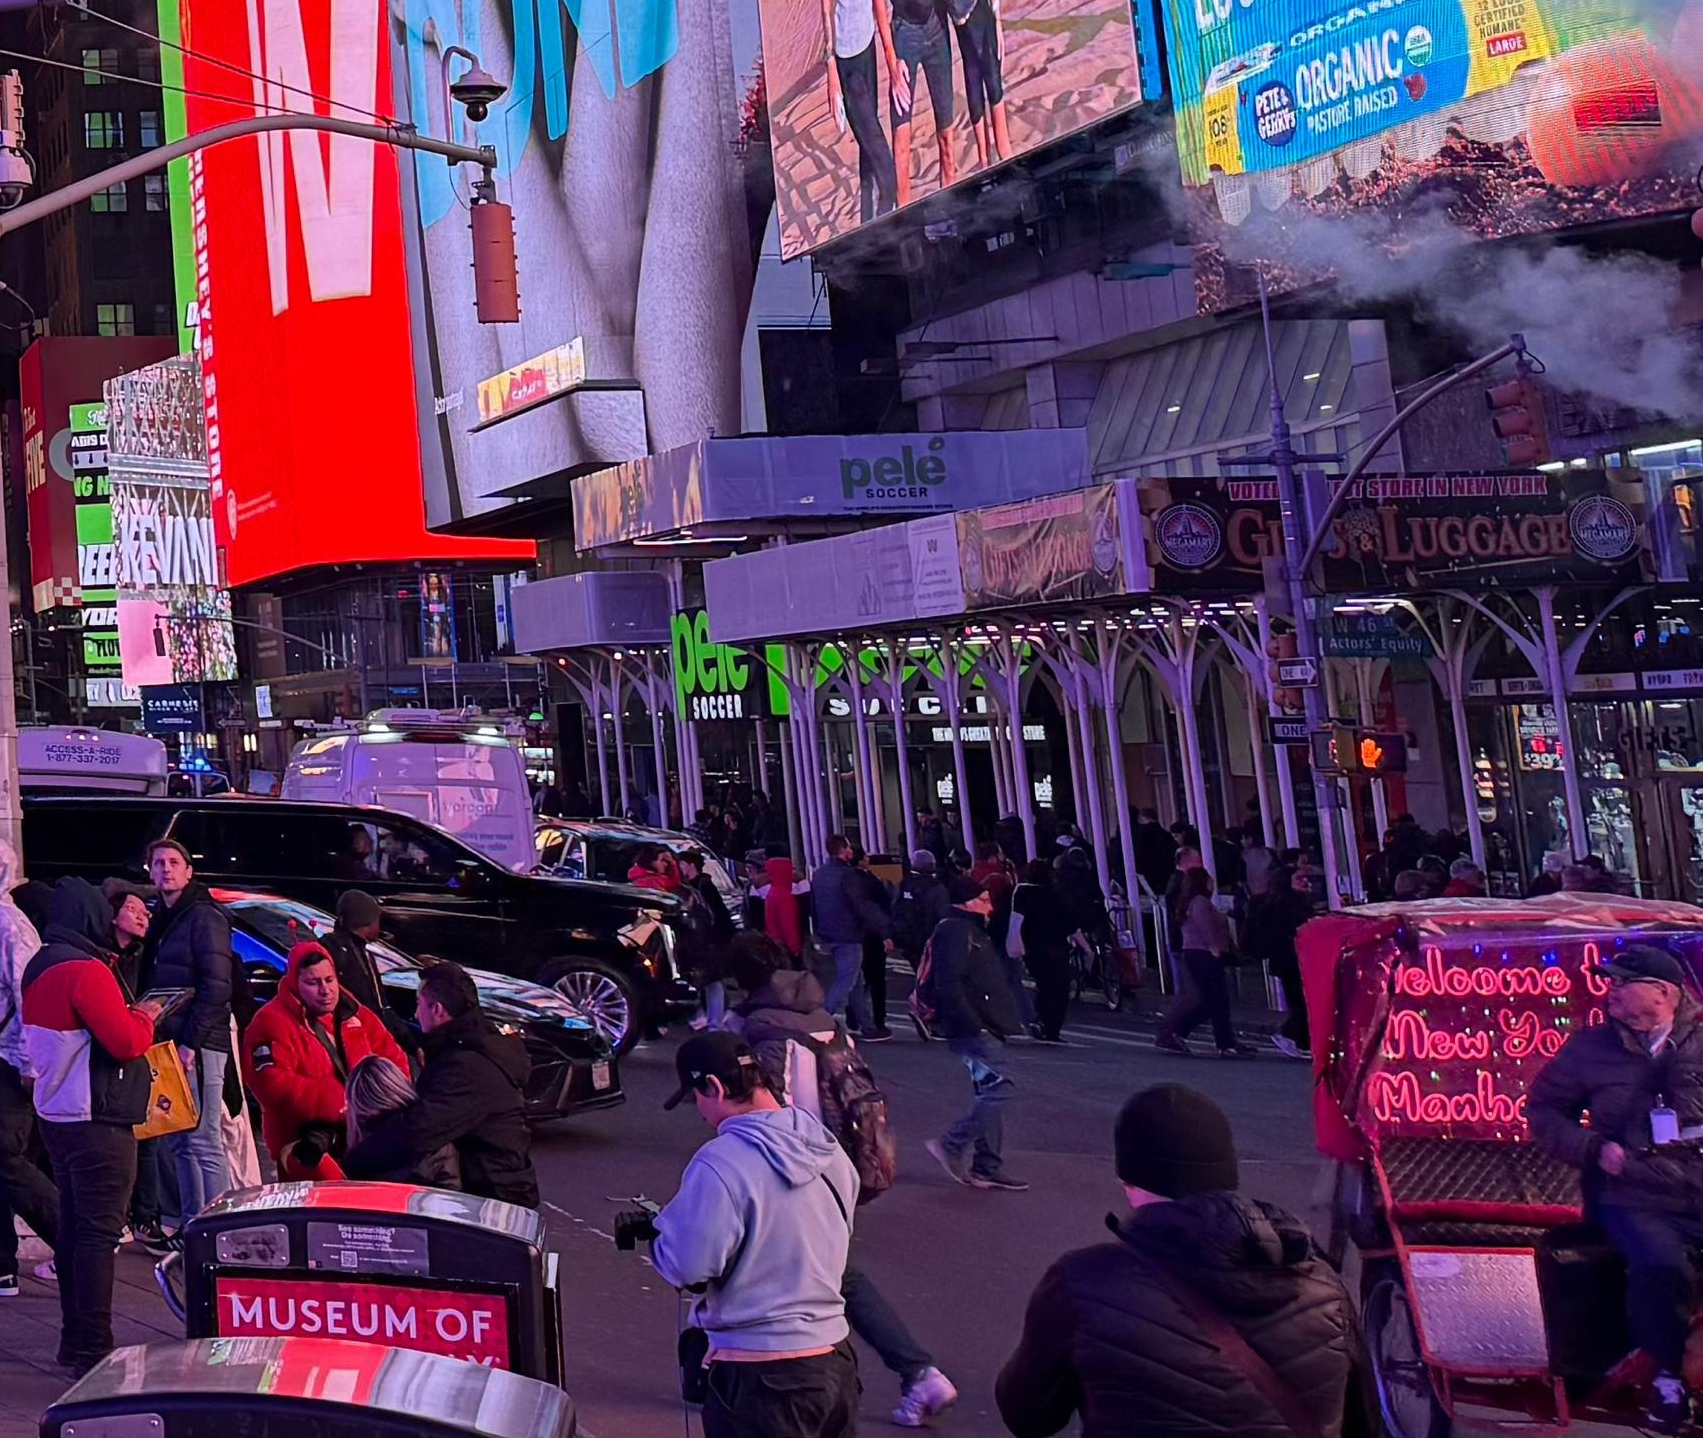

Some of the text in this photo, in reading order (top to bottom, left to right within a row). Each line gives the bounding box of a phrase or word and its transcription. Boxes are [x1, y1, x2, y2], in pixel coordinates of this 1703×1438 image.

[1473, 5, 1525, 27] CERTIFIED
[1489, 35, 1524, 53] LARGE
[1296, 29, 1405, 110] ORGANIC
[1255, 87, 1281, 117] PETE
[1354, 85, 1398, 119] RAISED
[840, 437, 947, 501] pelé
[865, 486, 929, 500] SOCCER
[1367, 475, 1548, 499] STORE IN NEW YORK
[1360, 506, 1572, 562] & LUGGAGE
[1333, 617, 1377, 635] W 46
[1381, 635, 1423, 655] Equity
[693, 694, 744, 721] SOCCER
[1281, 723, 1307, 739] ONE
[45, 744, 121, 756] ACCESS-A-RIDE
[46, 754, 120, 765] 1-877-337-2017
[1385, 1010, 1490, 1060] New
[231, 1293, 492, 1344] MUSEUM OF
